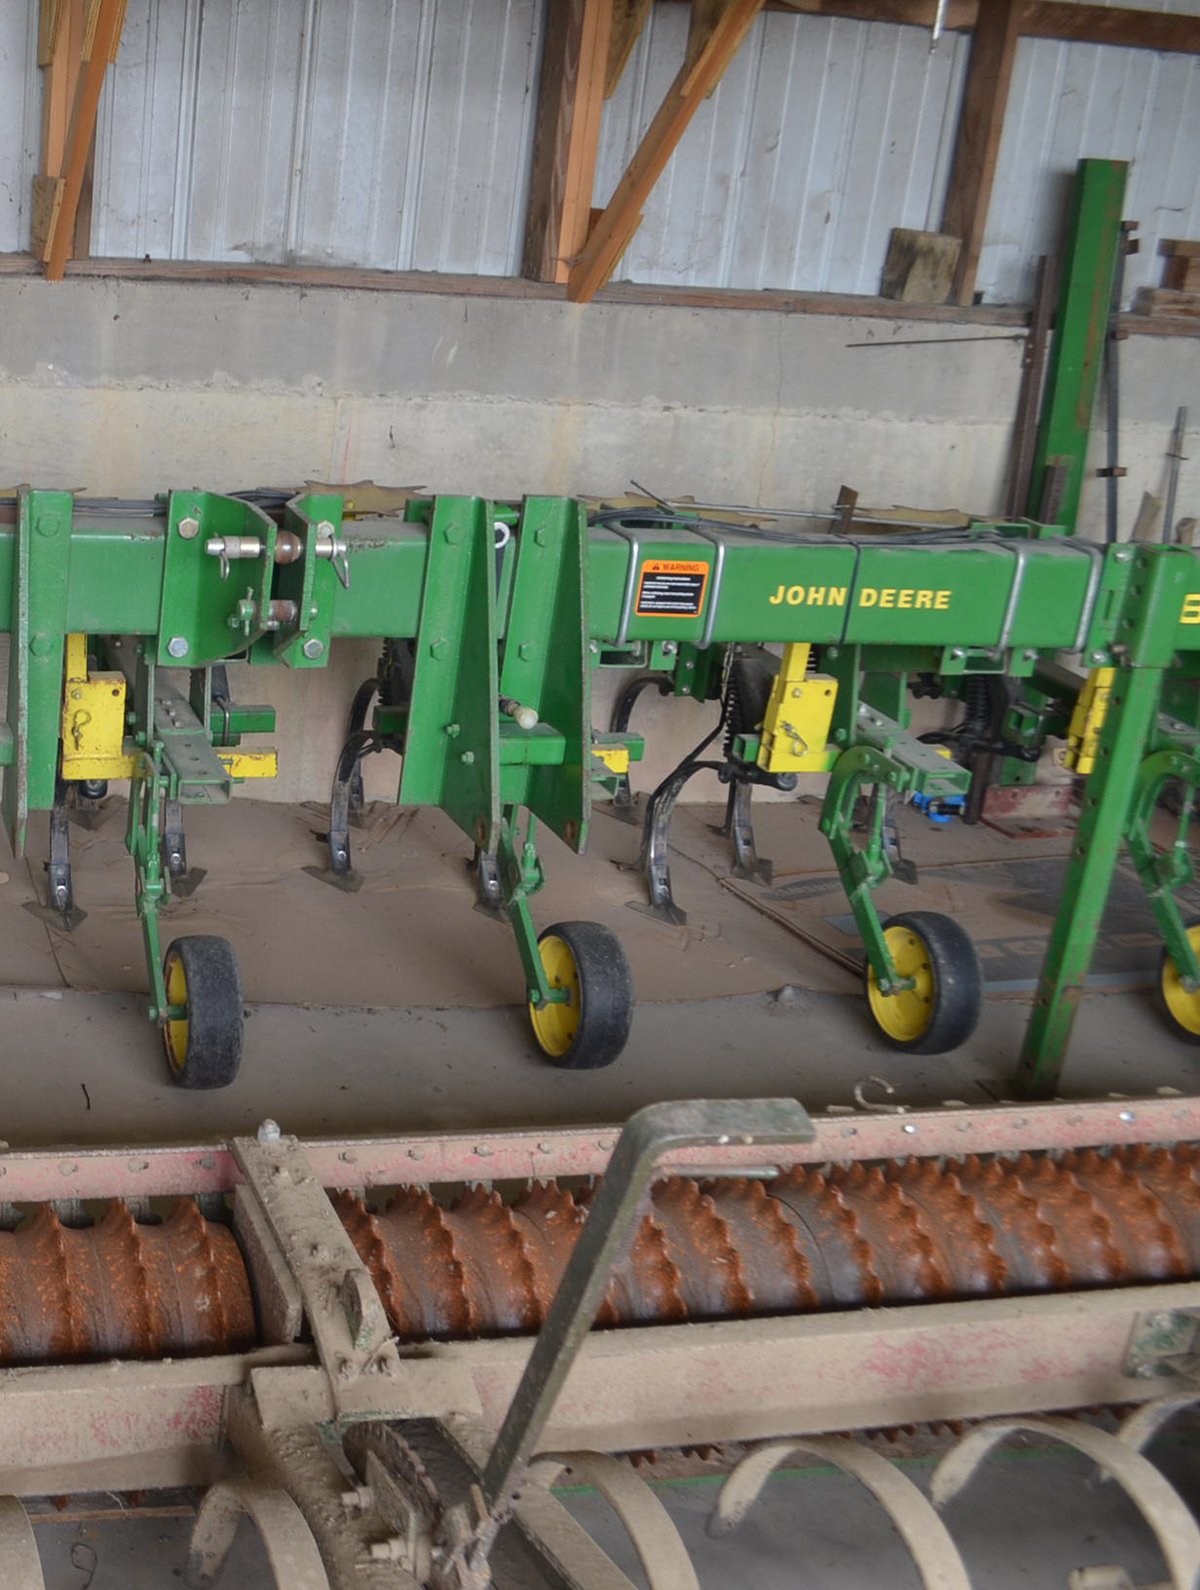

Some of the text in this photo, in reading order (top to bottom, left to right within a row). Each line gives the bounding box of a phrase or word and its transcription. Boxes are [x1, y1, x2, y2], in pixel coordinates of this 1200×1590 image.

[663, 563, 699, 572] WARNING
[769, 585, 952, 609] JOHN DEERE
